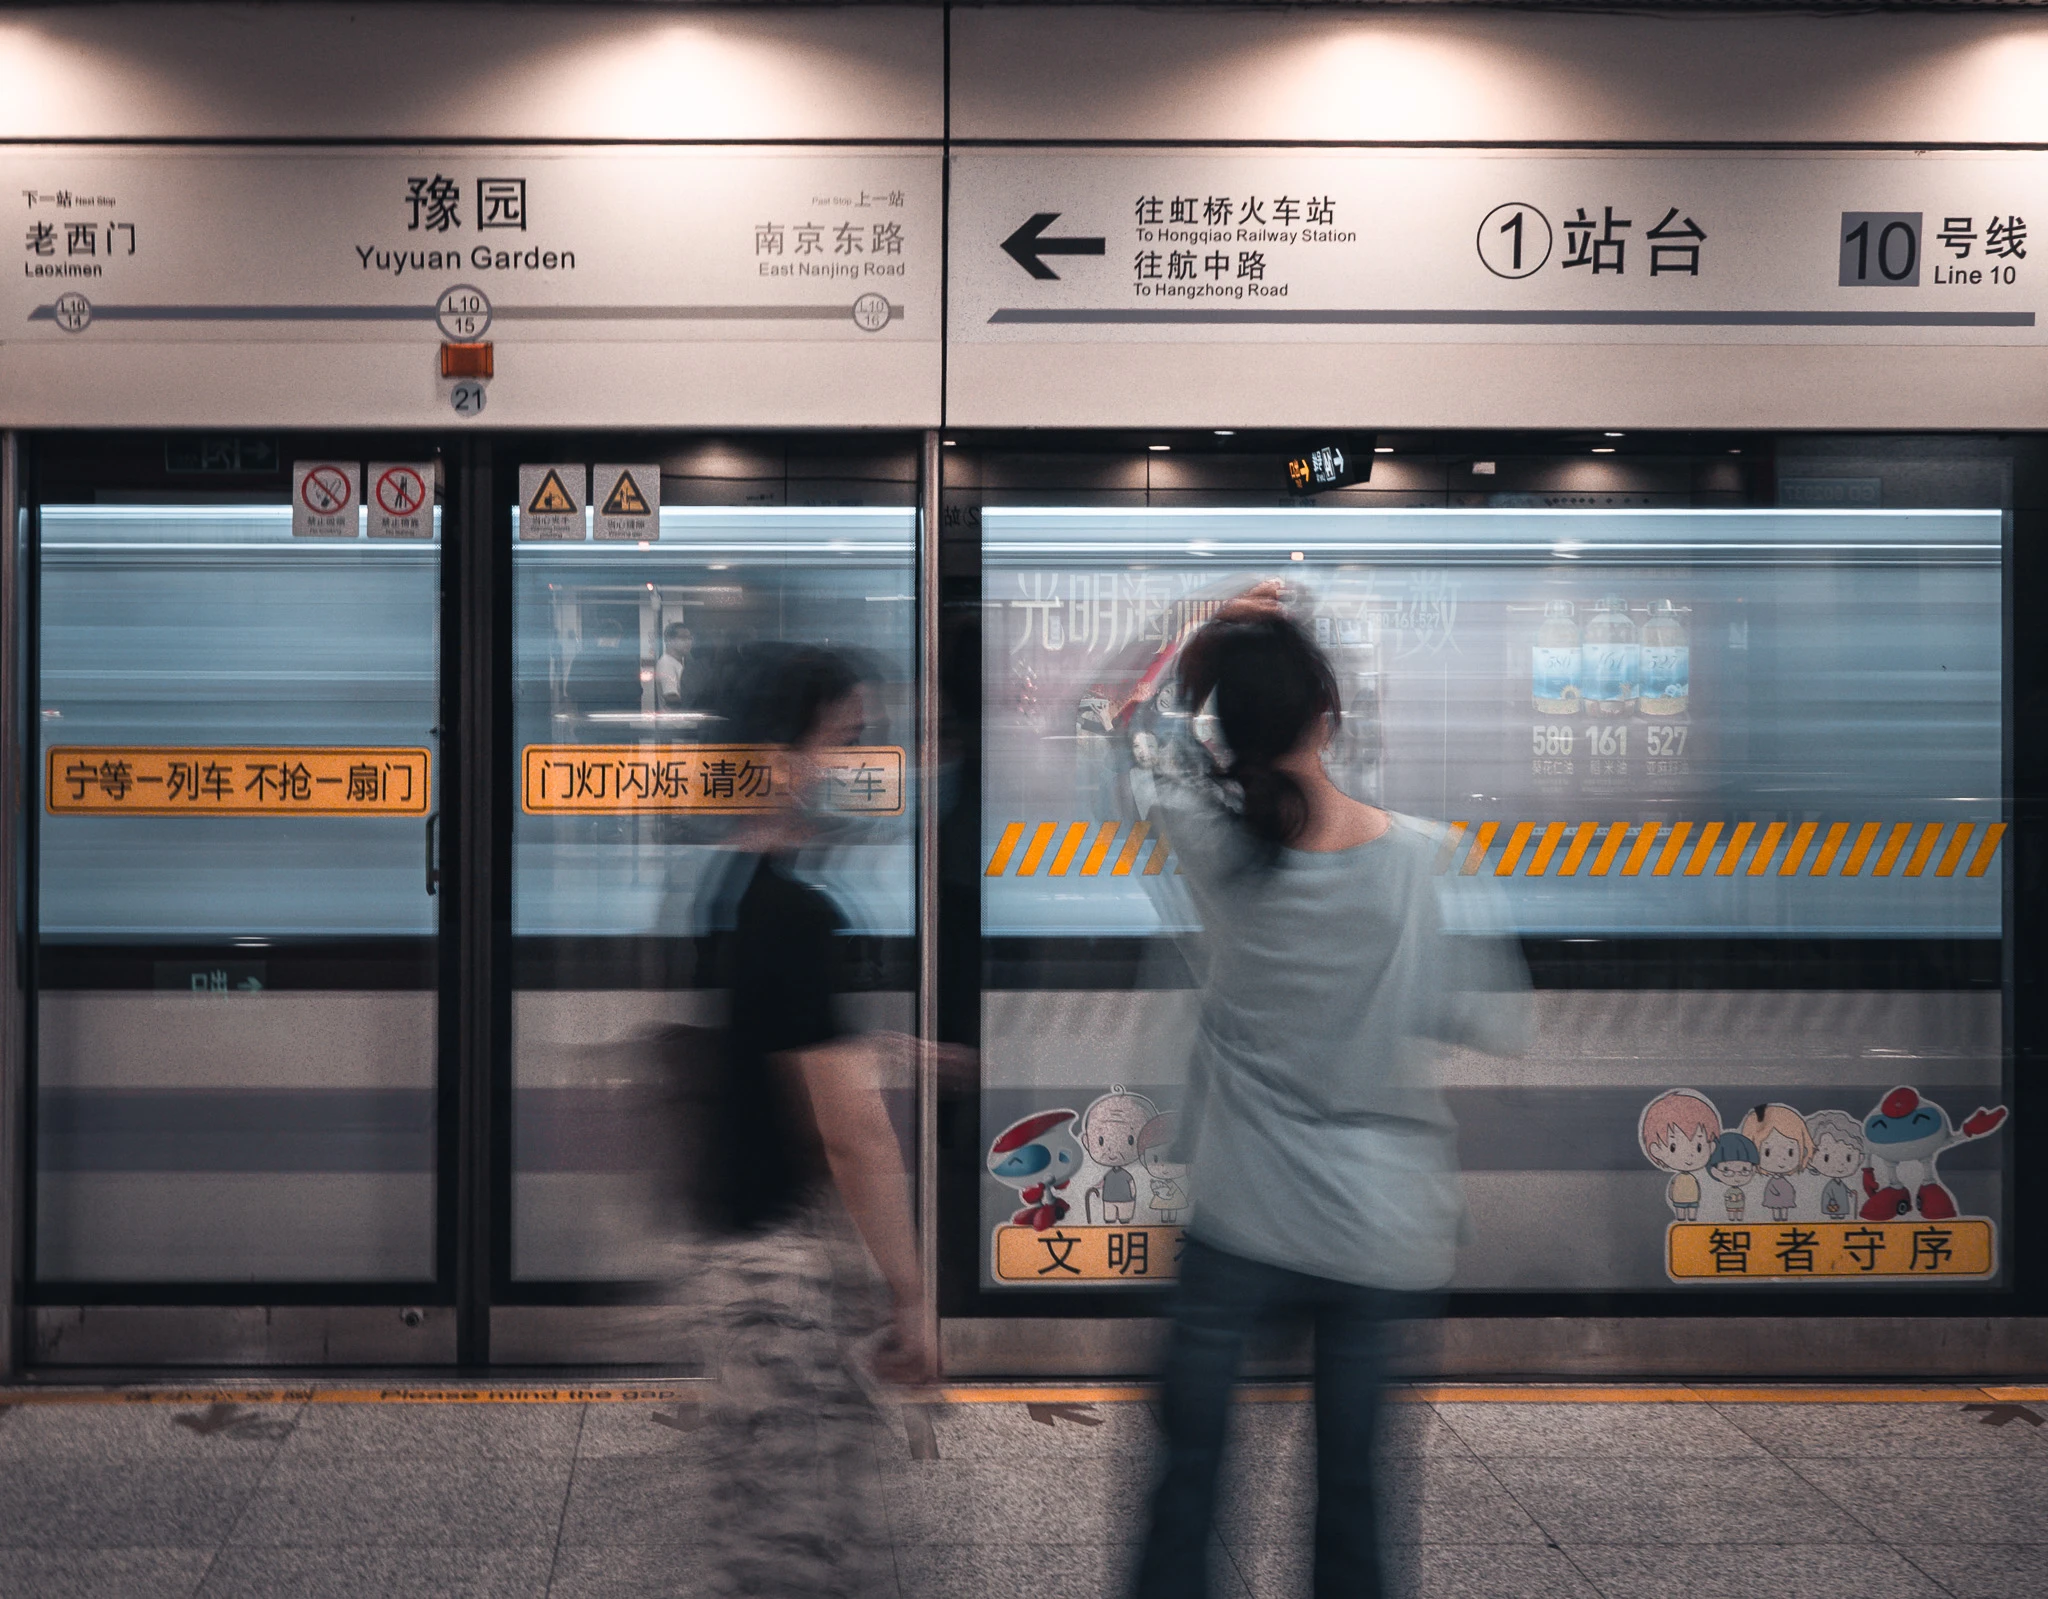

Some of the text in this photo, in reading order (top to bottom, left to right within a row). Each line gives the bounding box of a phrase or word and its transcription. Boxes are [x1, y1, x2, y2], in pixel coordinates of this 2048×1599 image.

[22, 190, 72, 209] 下一站
[406, 173, 527, 233] 豫园
[854, 190, 905, 208] 上一站
[1134, 195, 1336, 226] 往虹桥火车站
[26, 221, 136, 257] 老西门
[755, 221, 905, 256] 南京东路
[1136, 228, 1356, 245] To Hongqiao Railway Station
[1936, 215, 2028, 260] 号线
[25, 261, 102, 277] Laoximen
[355, 245, 576, 276] Yuyuan Garden
[759, 262, 905, 280] East Nanjing Road
[1133, 249, 1267, 281] 往航中路
[1934, 265, 2016, 285] Line 10
[60, 300, 86, 313] L10
[448, 296, 480, 313] L10
[858, 300, 884, 313] L10
[1133, 283, 1288, 300] To Hangzhong Road
[455, 318, 476, 334] 15
[455, 389, 481, 411] 21
[1532, 725, 1574, 756] 580
[1585, 725, 1628, 756] 161
[1647, 725, 1689, 756] 527
[65, 760, 413, 802] 宁等一列车 不抢一扇门
[541, 761, 689, 800] 门灯闪烁
[1037, 1230, 1188, 1276] 文明
[1708, 1226, 1953, 1273] 智者守序
